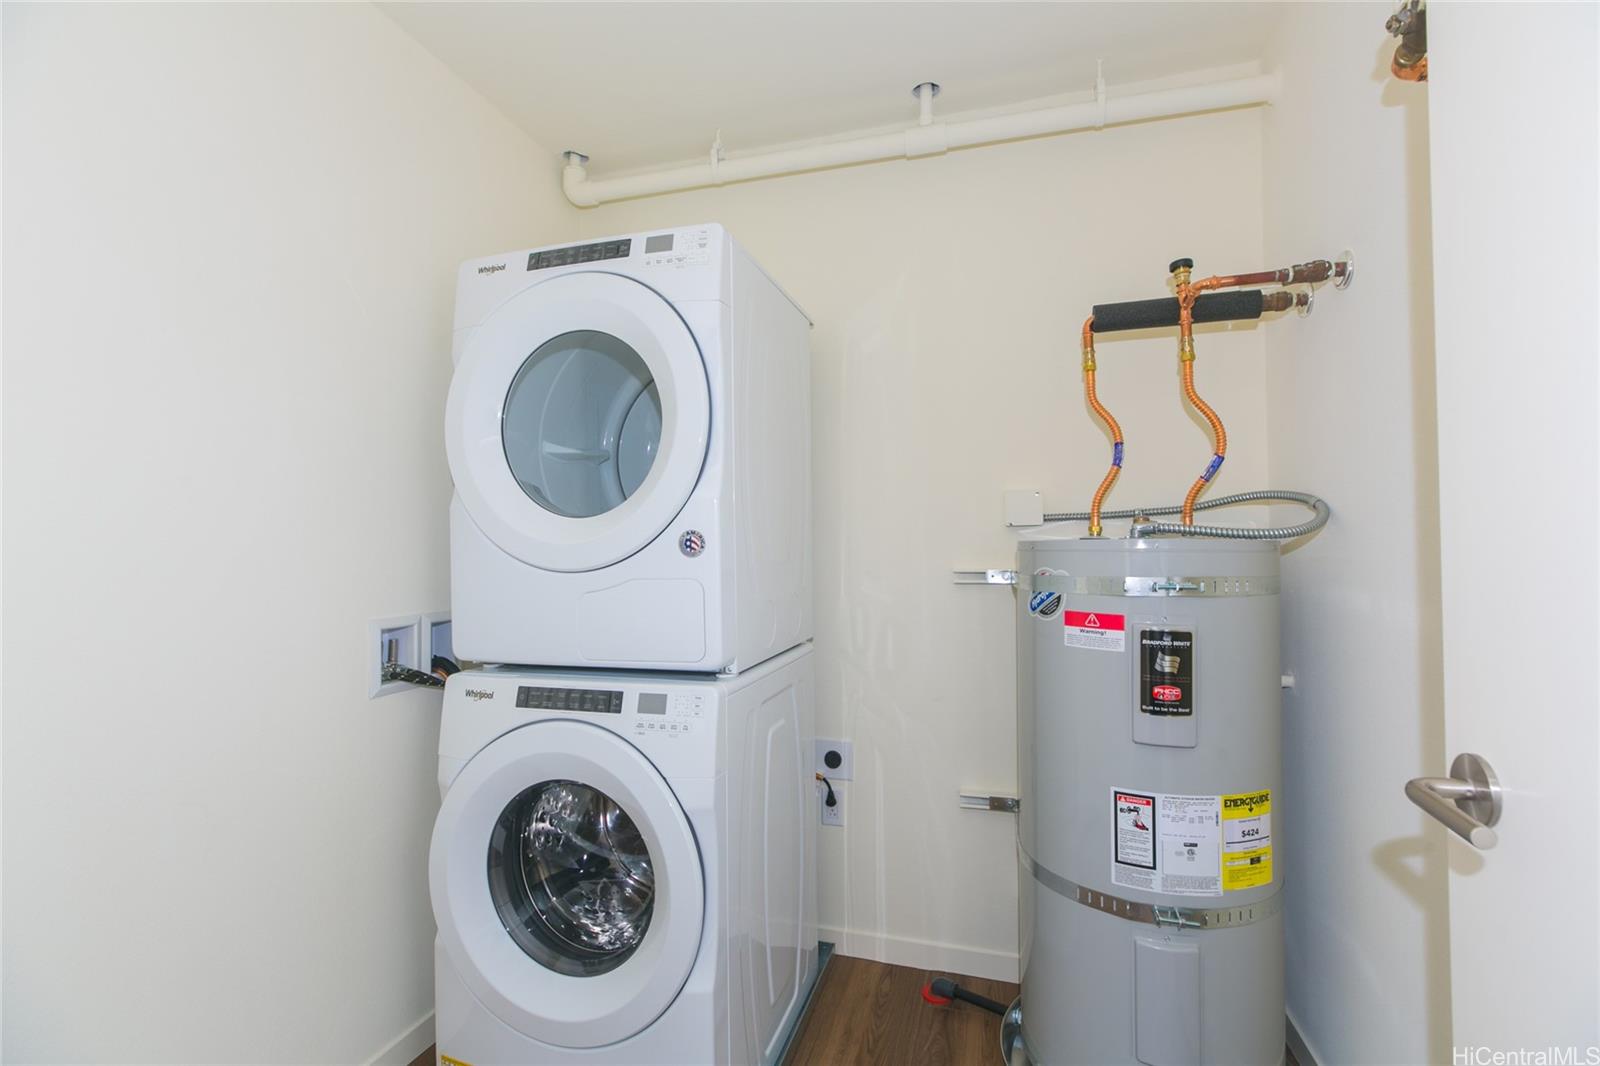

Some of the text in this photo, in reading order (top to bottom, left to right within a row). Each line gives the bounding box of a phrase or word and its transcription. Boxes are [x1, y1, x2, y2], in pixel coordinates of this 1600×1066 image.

[478, 263, 506, 275] Whirlpool
[1080, 628, 1106, 636] Warning!
[465, 689, 494, 701] Whirlpool
[1241, 828, 1259, 838] $424
